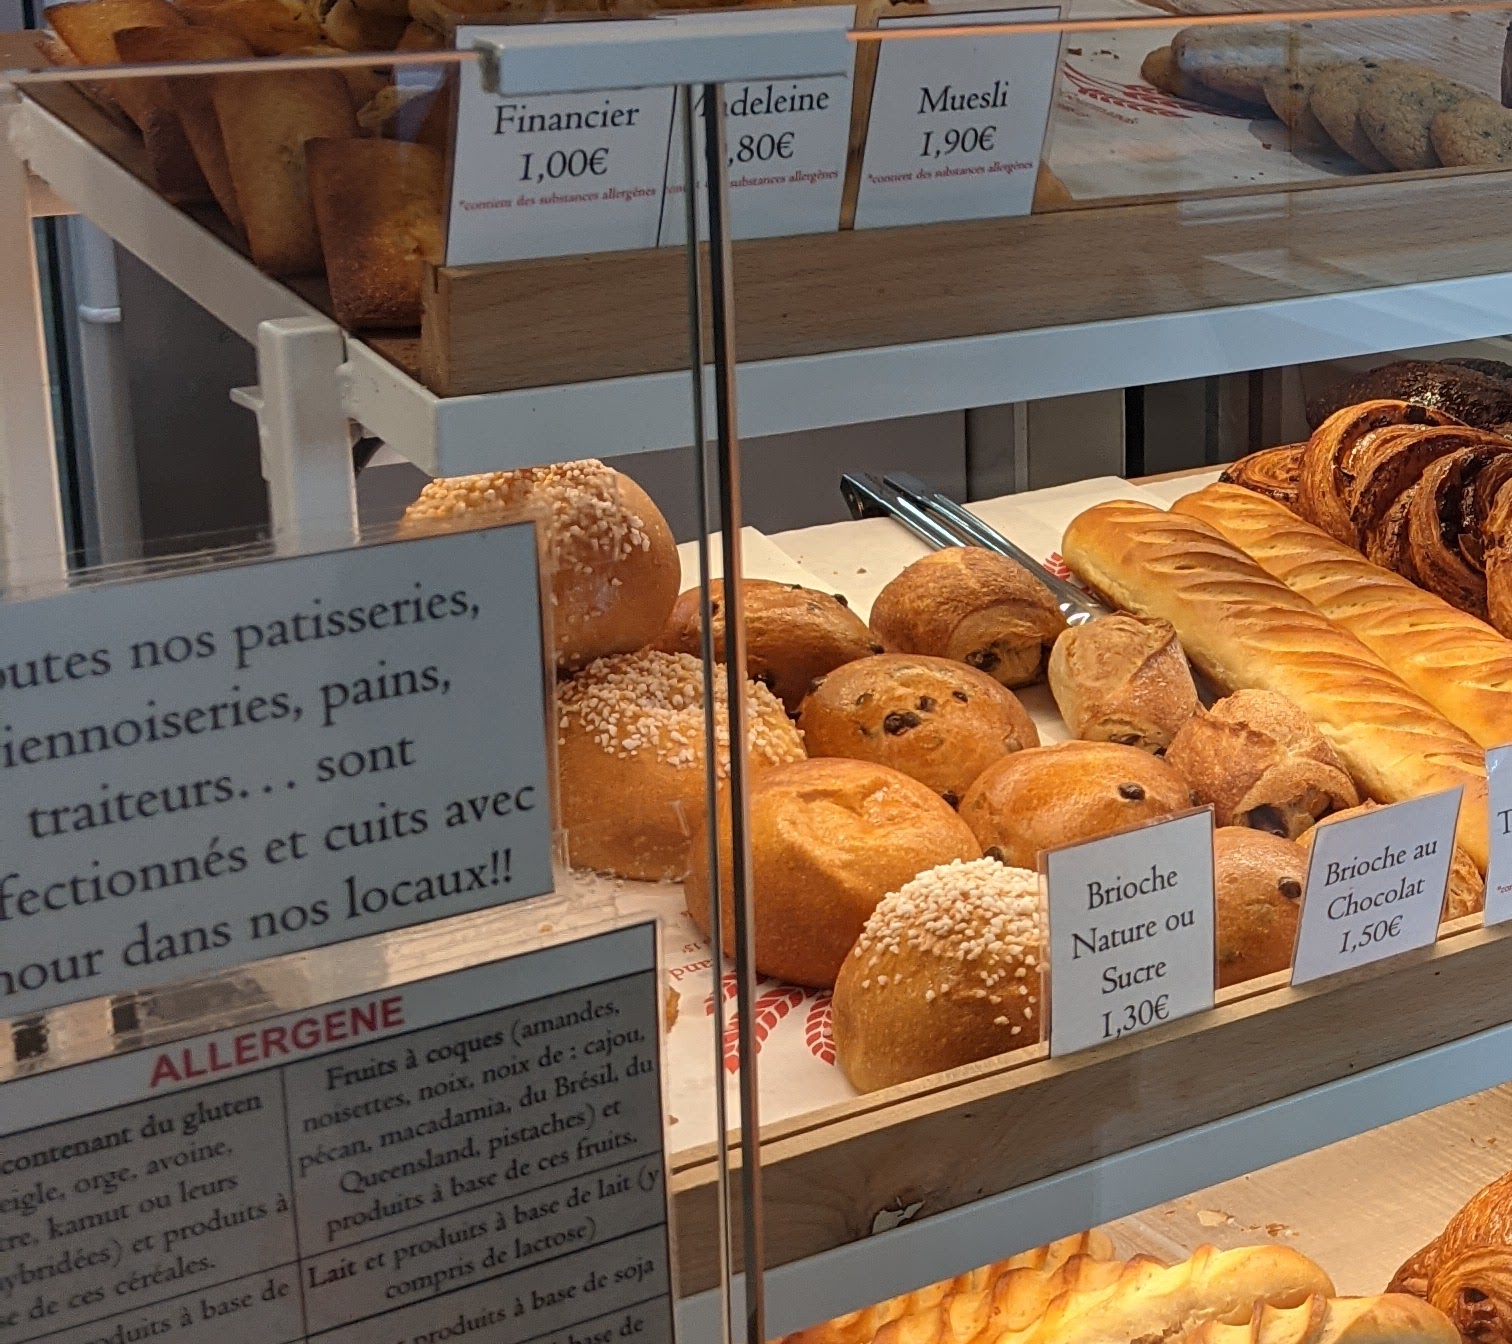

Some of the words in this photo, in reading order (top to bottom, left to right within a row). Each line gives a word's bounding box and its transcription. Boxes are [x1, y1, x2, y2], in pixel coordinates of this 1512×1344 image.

[493, 100, 640, 136] Financier
[917, 79, 1011, 114] Muesli
[519, 147, 609, 184] 1,00€
[727, 132, 795, 167] ,80€
[919, 126, 998, 159] 1,90€
[516, 193, 536, 206] des
[538, 189, 600, 205] substances
[130, 630, 216, 669] nos
[231, 583, 481, 668] patisseries,
[320, 661, 451, 727] pains,
[316, 736, 416, 785] sont
[265, 830, 306, 865] et
[324, 798, 428, 853] cuits
[445, 781, 536, 824] avec
[1086, 864, 1179, 911] Brioche
[1323, 845, 1407, 889] Brioche
[1412, 838, 1439, 863] au
[122, 920, 232, 967] dans
[249, 894, 330, 939] nos
[346, 847, 514, 919] locaux!!
[1326, 875, 1427, 922] Chocolat
[1070, 917, 1158, 961] Nature
[1165, 906, 1196, 933] ou
[1338, 913, 1404, 956] 1,50€
[1101, 960, 1168, 996] Sucre
[149, 995, 406, 1088] ALLERGENE
[1101, 993, 1171, 1040] 1,30€
[325, 1058, 398, 1091] Fruits
[406, 1048, 418, 1070] à
[426, 1031, 505, 1065] coques
[511, 1000, 620, 1047] (amandes,
[303, 1093, 411, 1133] noisettes,
[419, 1074, 475, 1102] noix,
[482, 1061, 530, 1085] noix
[538, 1045, 564, 1068] de
[583, 1027, 645, 1056] cajou,
[1, 1125, 133, 1176] contenant
[140, 1114, 174, 1140] du
[182, 1094, 263, 1136] gluten
[300, 1138, 373, 1178] pécan,
[379, 1098, 513, 1148] macadamia,
[520, 1082, 547, 1107] du
[626, 1056, 654, 1078] du
[339, 1140, 480, 1194] Queensland,
[488, 1104, 597, 1155] pistaches)
[602, 1099, 622, 1120] et
[326, 1191, 424, 1242] produits
[432, 1183, 443, 1205] à
[451, 1172, 498, 1198] base
[505, 1157, 531, 1181] de
[538, 1149, 570, 1171] ces
[576, 1129, 638, 1161] fruits.
[513, 1297, 525, 1318] à
[532, 1284, 577, 1311] base
[584, 1270, 609, 1293] de
[615, 1258, 656, 1287] soja
